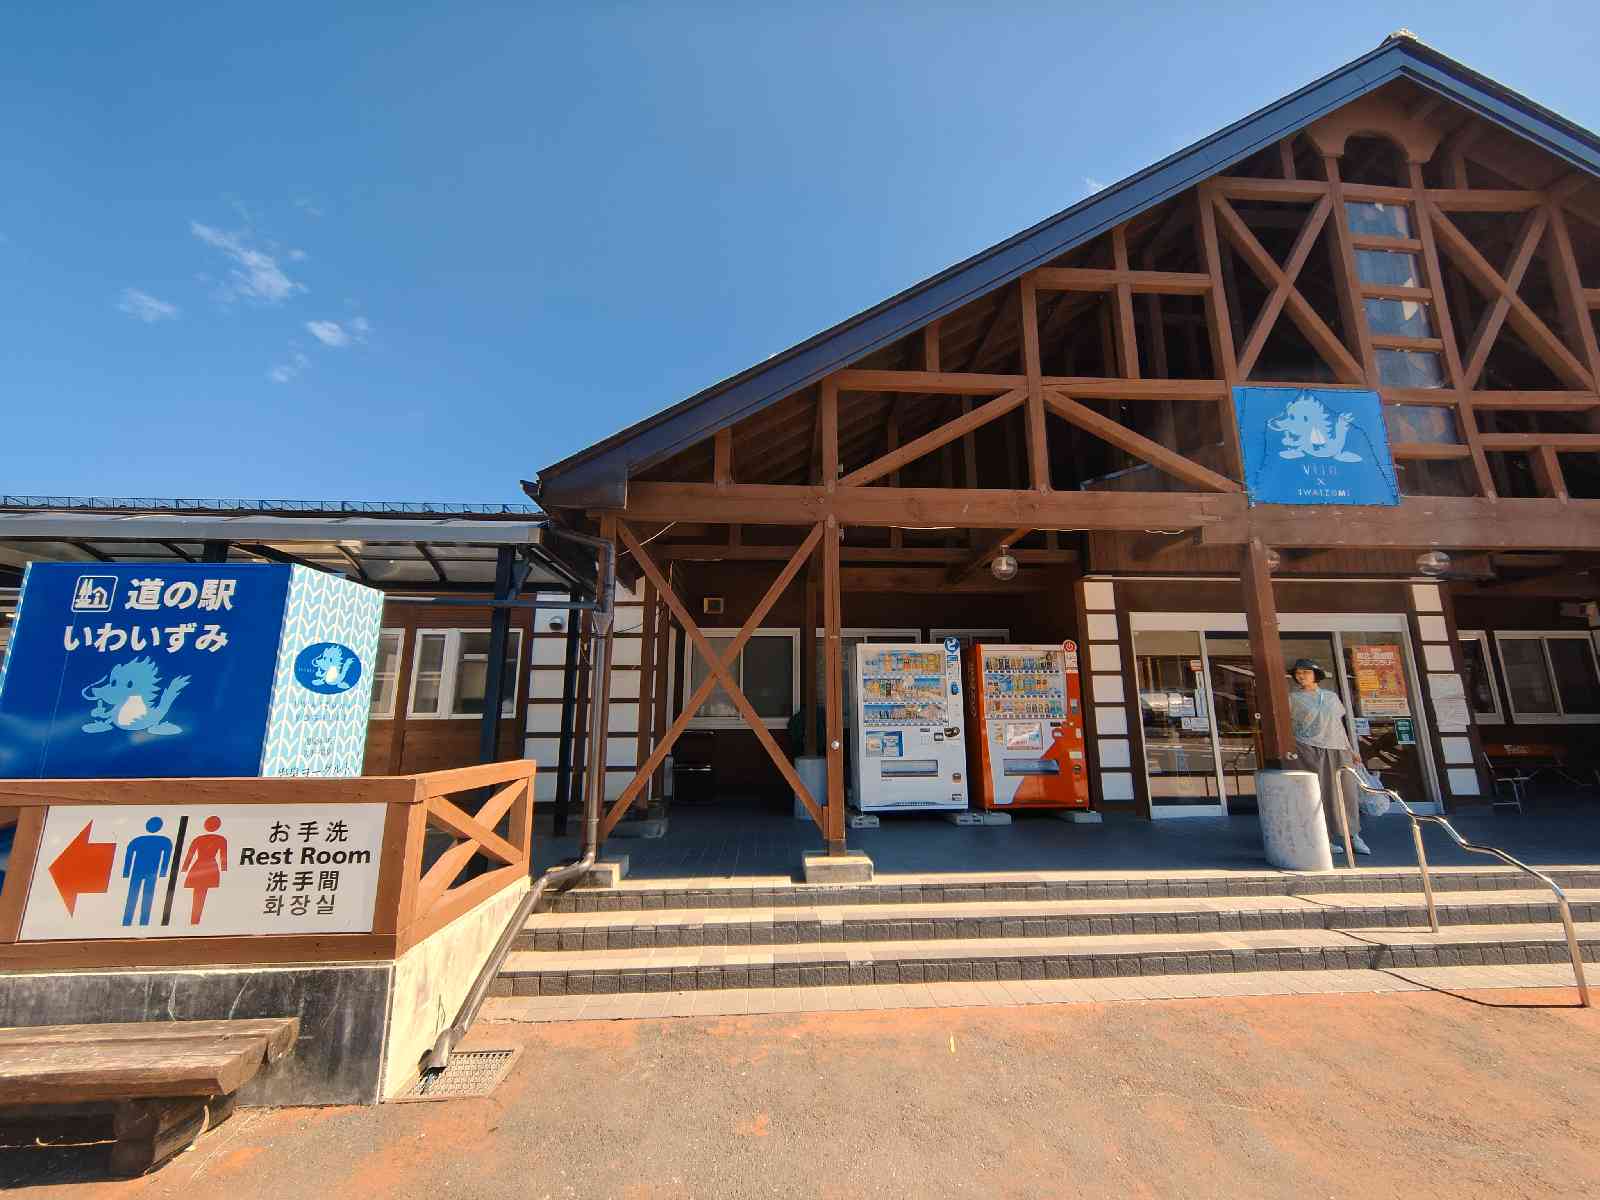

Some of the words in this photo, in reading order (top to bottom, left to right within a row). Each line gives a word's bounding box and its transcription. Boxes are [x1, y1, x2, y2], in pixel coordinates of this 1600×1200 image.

[125, 578, 237, 611] 道の駅
[64, 622, 230, 653] いわいずみ
[269, 820, 349, 843] お手洗
[240, 848, 295, 866] Rest
[300, 848, 371, 865] Room
[265, 870, 340, 892] 洗手間
[263, 894, 337, 916] 화장실
